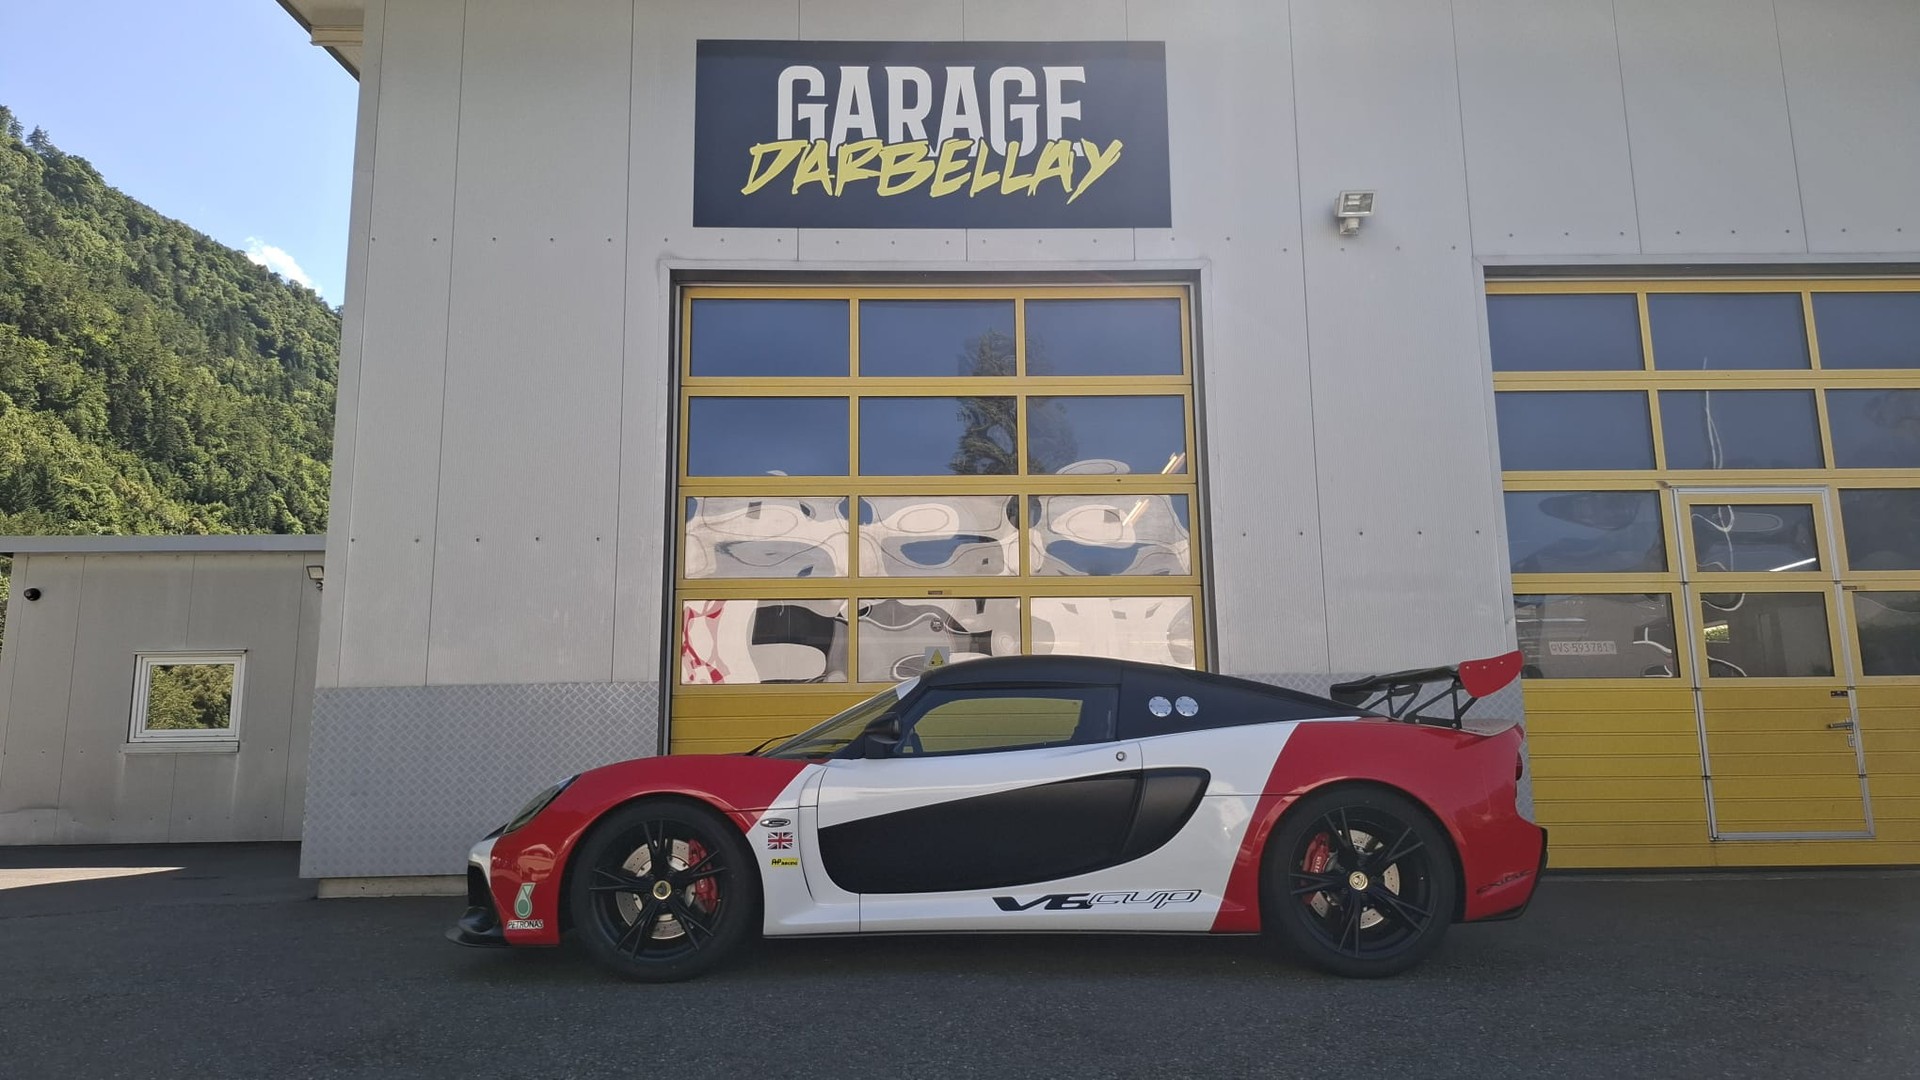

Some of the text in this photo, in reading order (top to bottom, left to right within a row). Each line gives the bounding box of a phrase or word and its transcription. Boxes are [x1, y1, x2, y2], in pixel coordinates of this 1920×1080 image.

[777, 65, 1087, 158] GARAGE
[741, 137, 1124, 205] DARBELLAY
[992, 893, 1092, 911] V6
[507, 920, 543, 929] PETRONAS
